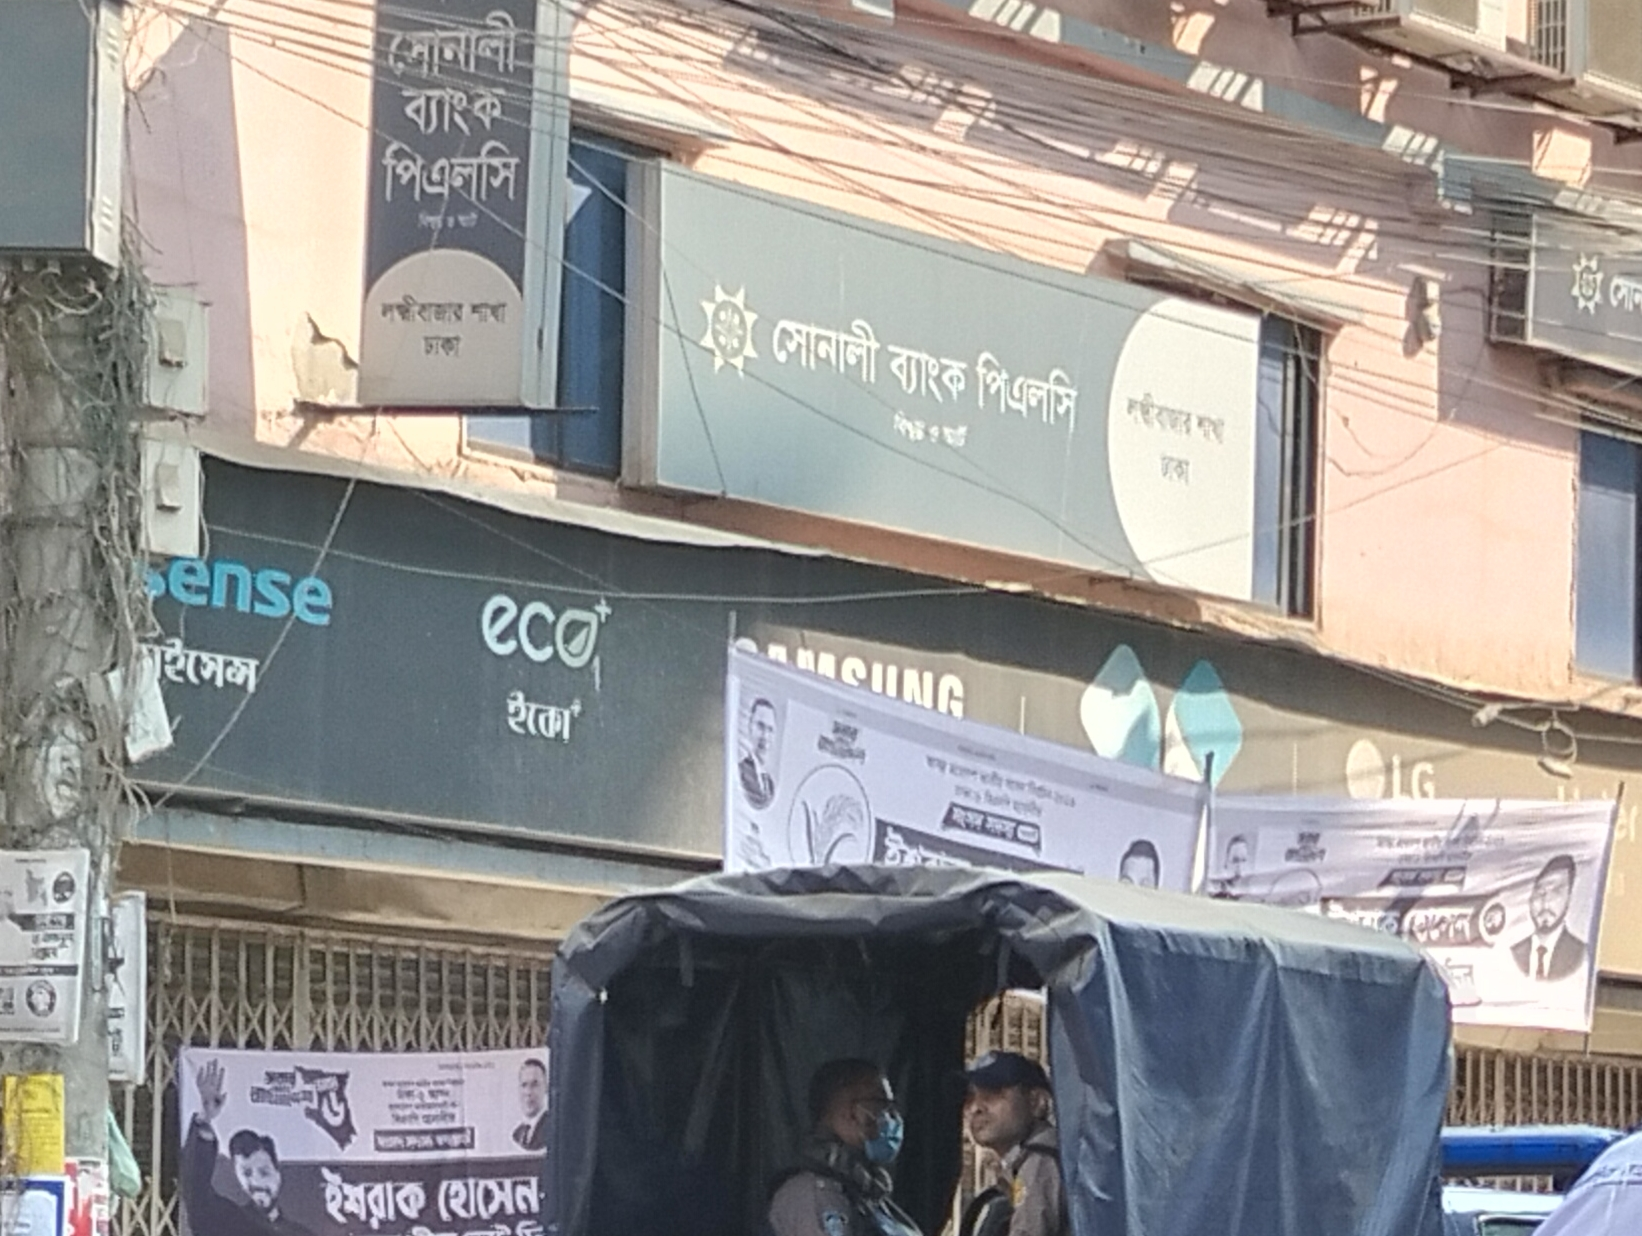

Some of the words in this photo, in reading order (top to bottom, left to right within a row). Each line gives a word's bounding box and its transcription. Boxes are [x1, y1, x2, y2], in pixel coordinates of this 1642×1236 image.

[388, 10, 514, 78] সোনালী
[402, 87, 506, 135] ব্যাংক
[382, 140, 520, 201] পিএলসি
[423, 335, 461, 356] ঢাকা
[773, 319, 880, 384] সোনালী
[887, 344, 968, 403] ব্যাংক
[976, 351, 1077, 434] পিএলসি
[140, 637, 259, 693] াইসেন্স
[735, 638, 964, 719] MSUNG
[1392, 754, 1435, 800] LG
[321, 1167, 427, 1230] ইশরাক
